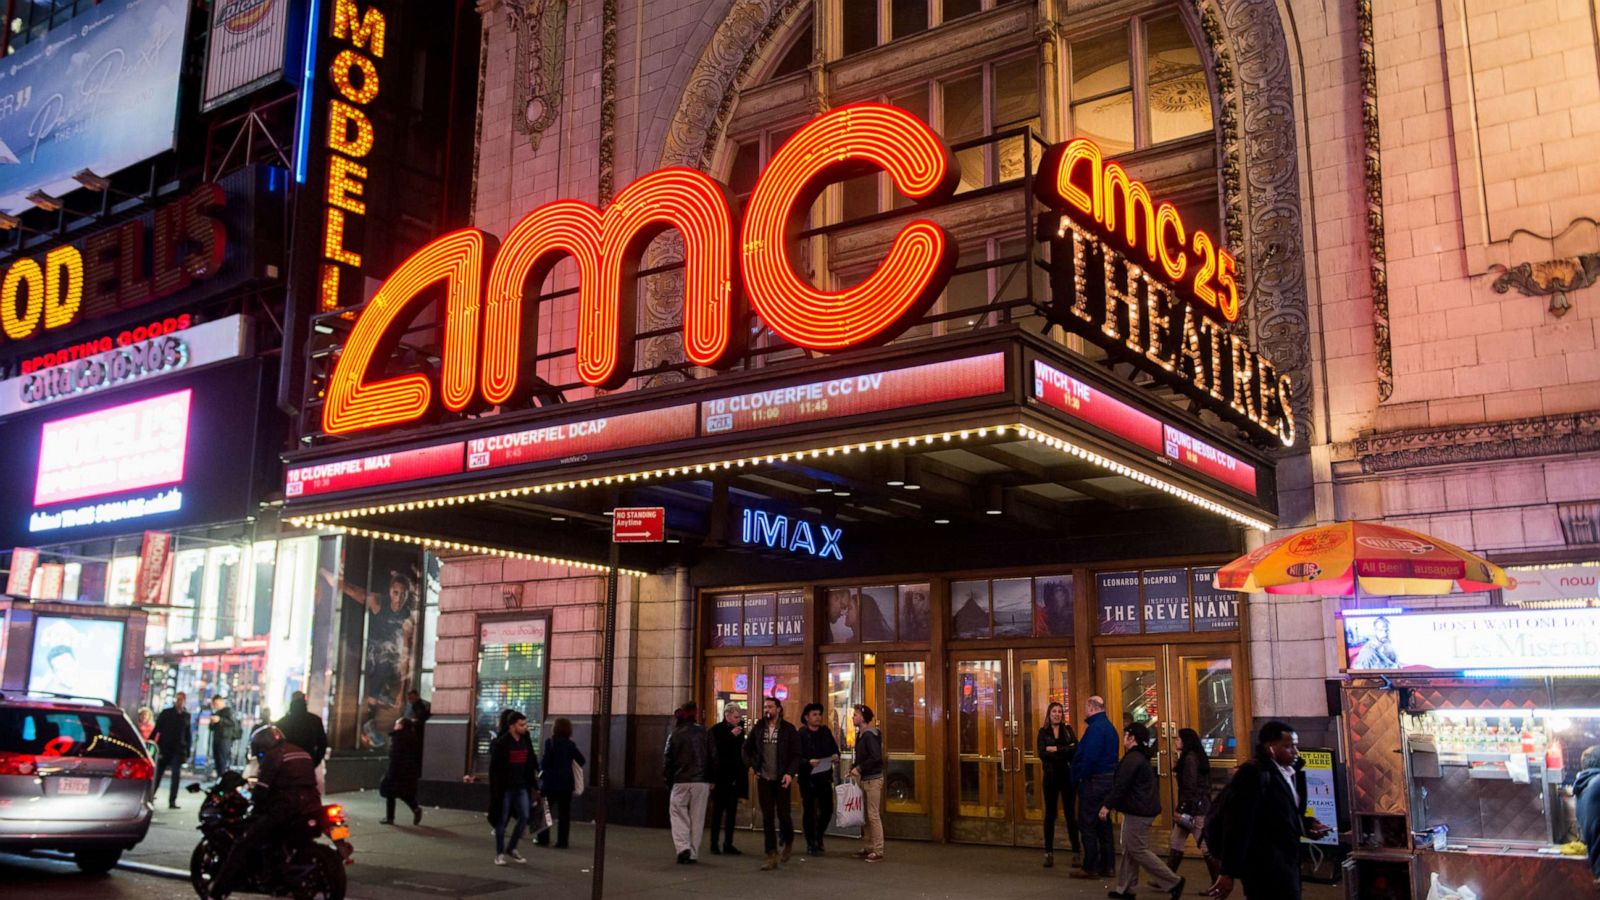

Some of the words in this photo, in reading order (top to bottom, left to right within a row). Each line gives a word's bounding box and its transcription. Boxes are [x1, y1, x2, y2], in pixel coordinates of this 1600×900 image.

[1193, 230, 1239, 323] 25
[1058, 215, 1297, 447] THEATRES
[21, 334, 113, 375] SPORTING
[117, 313, 191, 346] GOODS
[708, 400, 725, 415] 10
[729, 382, 823, 413] CLOVERFIE
[827, 377, 853, 397] CC
[858, 372, 884, 393] DV
[1071, 378, 1091, 403] THE
[751, 408, 779, 421] 11:00
[799, 400, 829, 414] 11:45
[472, 440, 484, 452] 10
[487, 426, 566, 451] CLOVERFIEL
[569, 418, 608, 439] DCAP
[1164, 424, 1191, 450] YOUNG
[289, 470, 299, 482] 10
[301, 460, 363, 481] CLOVERFIEL
[364, 453, 391, 471] IMAX
[616, 520, 643, 528] Anytime
[627, 511, 657, 519] STANDING
[743, 508, 843, 561] IMAX
[1103, 578, 1139, 587] LEONARDO
[1195, 573, 1211, 582] TOM
[1362, 562, 1376, 573] All
[1379, 563, 1399, 573] Bee
[1413, 565, 1460, 577] ausages
[1560, 576, 1595, 587] now
[779, 597, 790, 605] TOM
[1104, 605, 1136, 622] THE
[1144, 600, 1240, 621] REVENANT
[717, 623, 739, 637] THE
[744, 620, 804, 636] REVENAN
